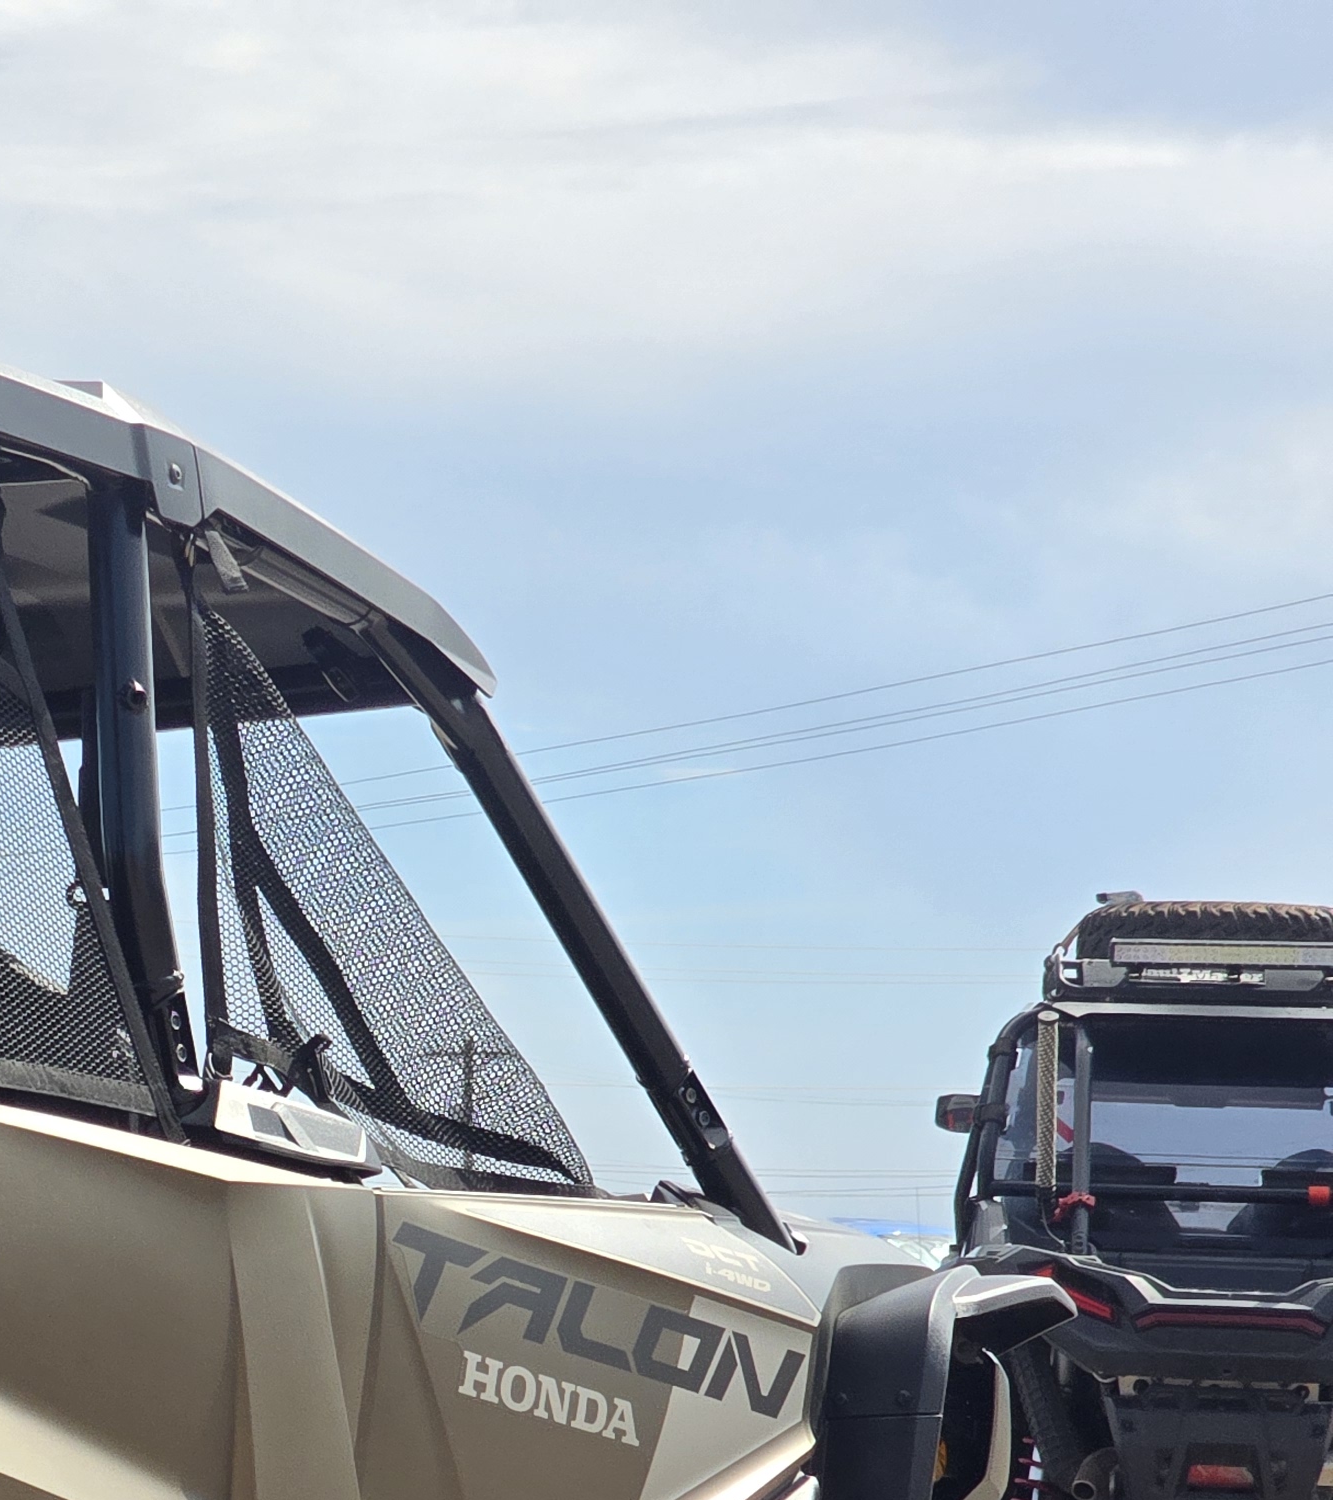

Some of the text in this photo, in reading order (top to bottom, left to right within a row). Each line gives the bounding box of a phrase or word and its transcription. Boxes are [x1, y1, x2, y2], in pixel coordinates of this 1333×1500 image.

[680, 1237, 759, 1272] DCT
[392, 1221, 806, 1419] TALON
[458, 1350, 640, 1447] HONDA
